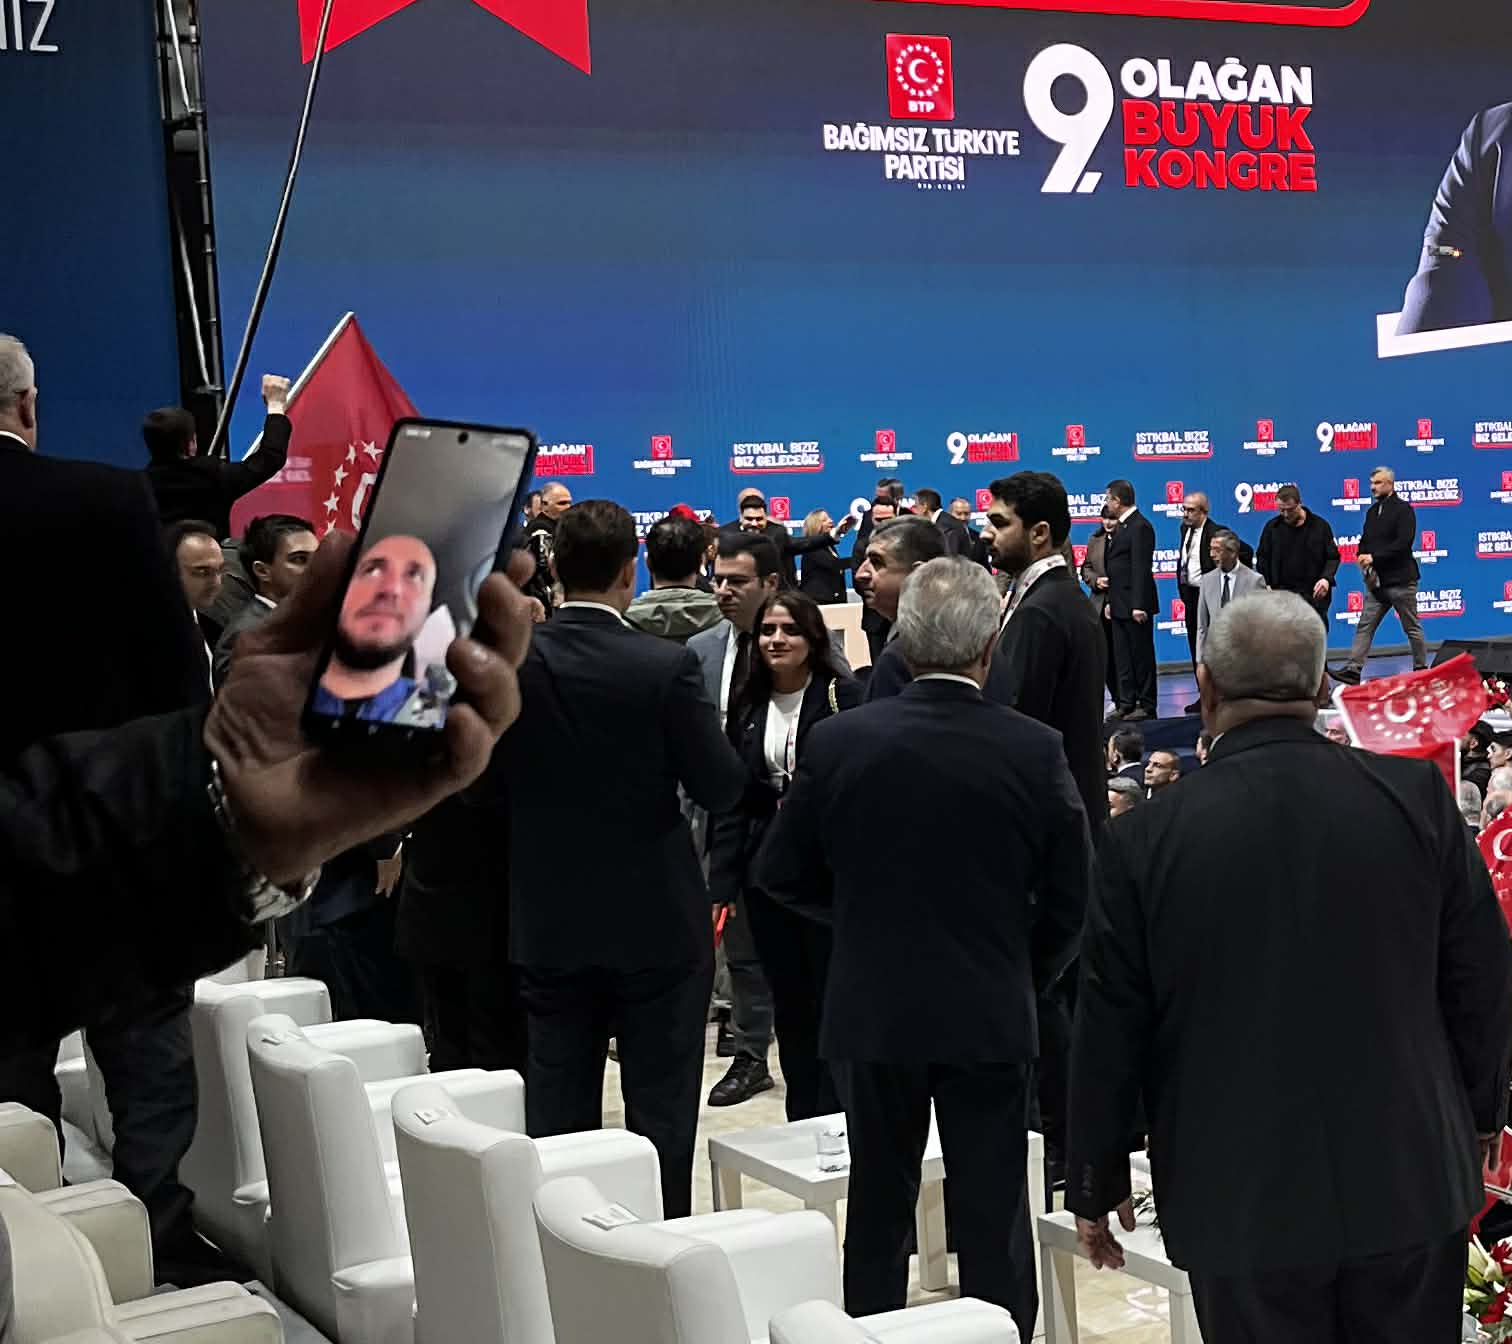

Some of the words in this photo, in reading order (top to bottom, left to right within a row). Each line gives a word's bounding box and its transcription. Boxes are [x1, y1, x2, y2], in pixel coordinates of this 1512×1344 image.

[1120, 56, 1313, 105] OLAĞAN
[907, 100, 936, 113] BTP
[823, 123, 930, 153] BAĞIMSIZ
[1123, 148, 1318, 192] KONGRE
